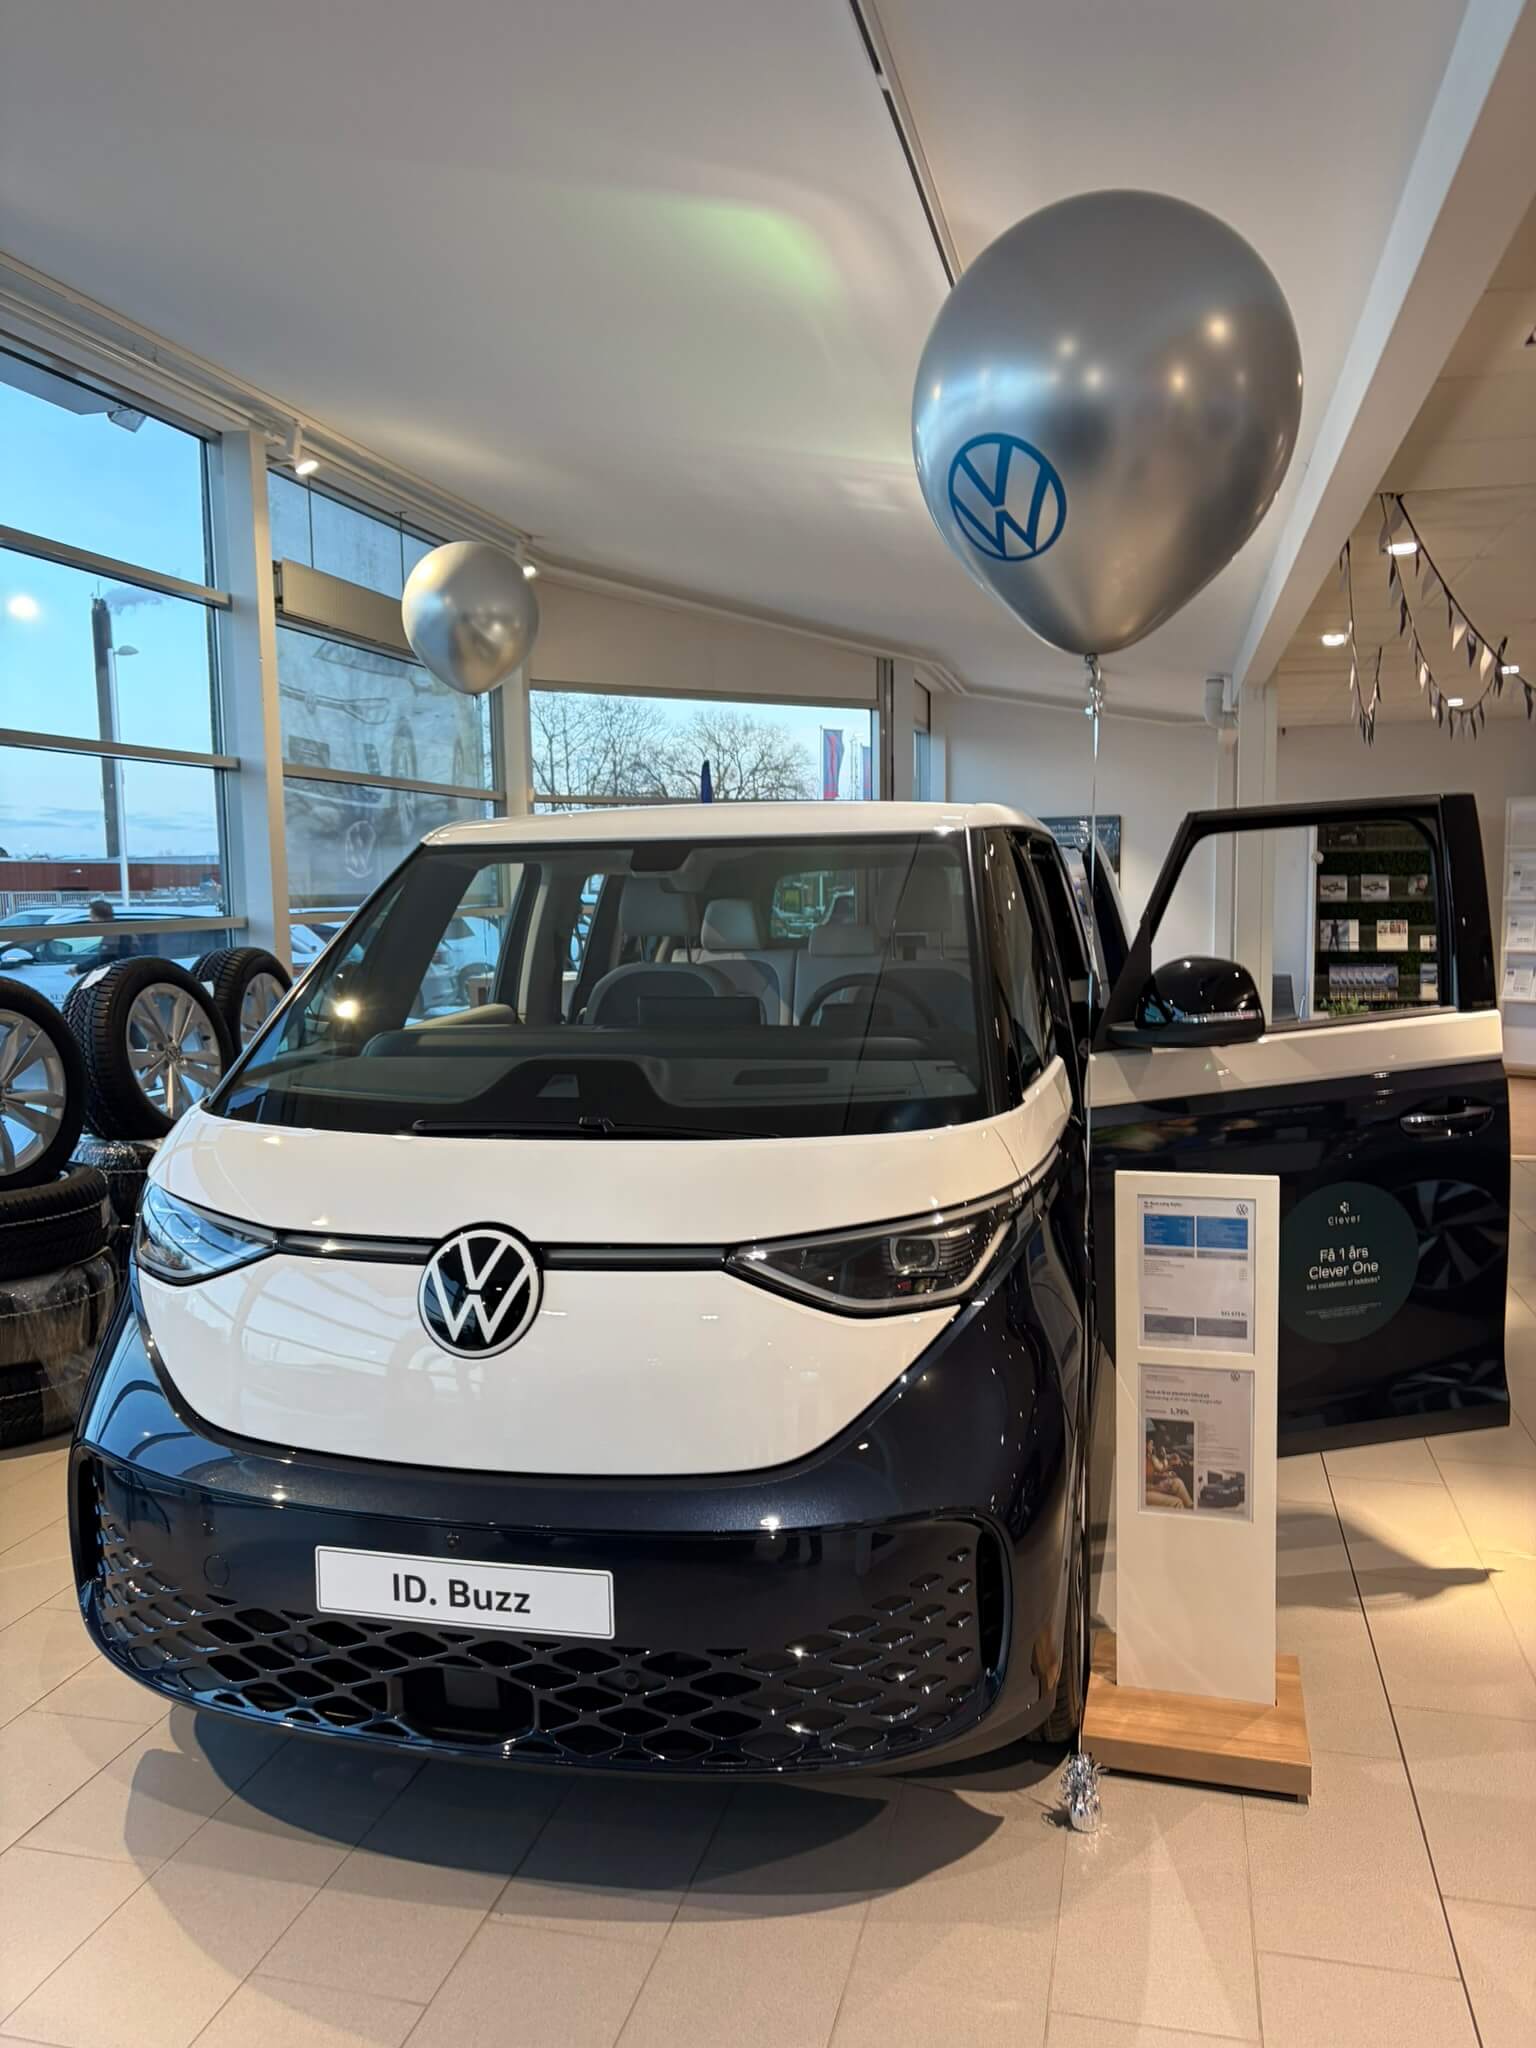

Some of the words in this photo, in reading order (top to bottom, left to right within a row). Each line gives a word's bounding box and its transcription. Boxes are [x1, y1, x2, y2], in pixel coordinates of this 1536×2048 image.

[1328, 1214, 1361, 1226] Clever
[1319, 1247, 1336, 1263] Få
[1339, 1247, 1345, 1261] 1
[1348, 1245, 1369, 1260] års
[1309, 1264, 1350, 1280] Clever
[1352, 1261, 1379, 1275] One
[392, 1573, 437, 1606] ID.
[449, 1578, 531, 1614] Buzz
